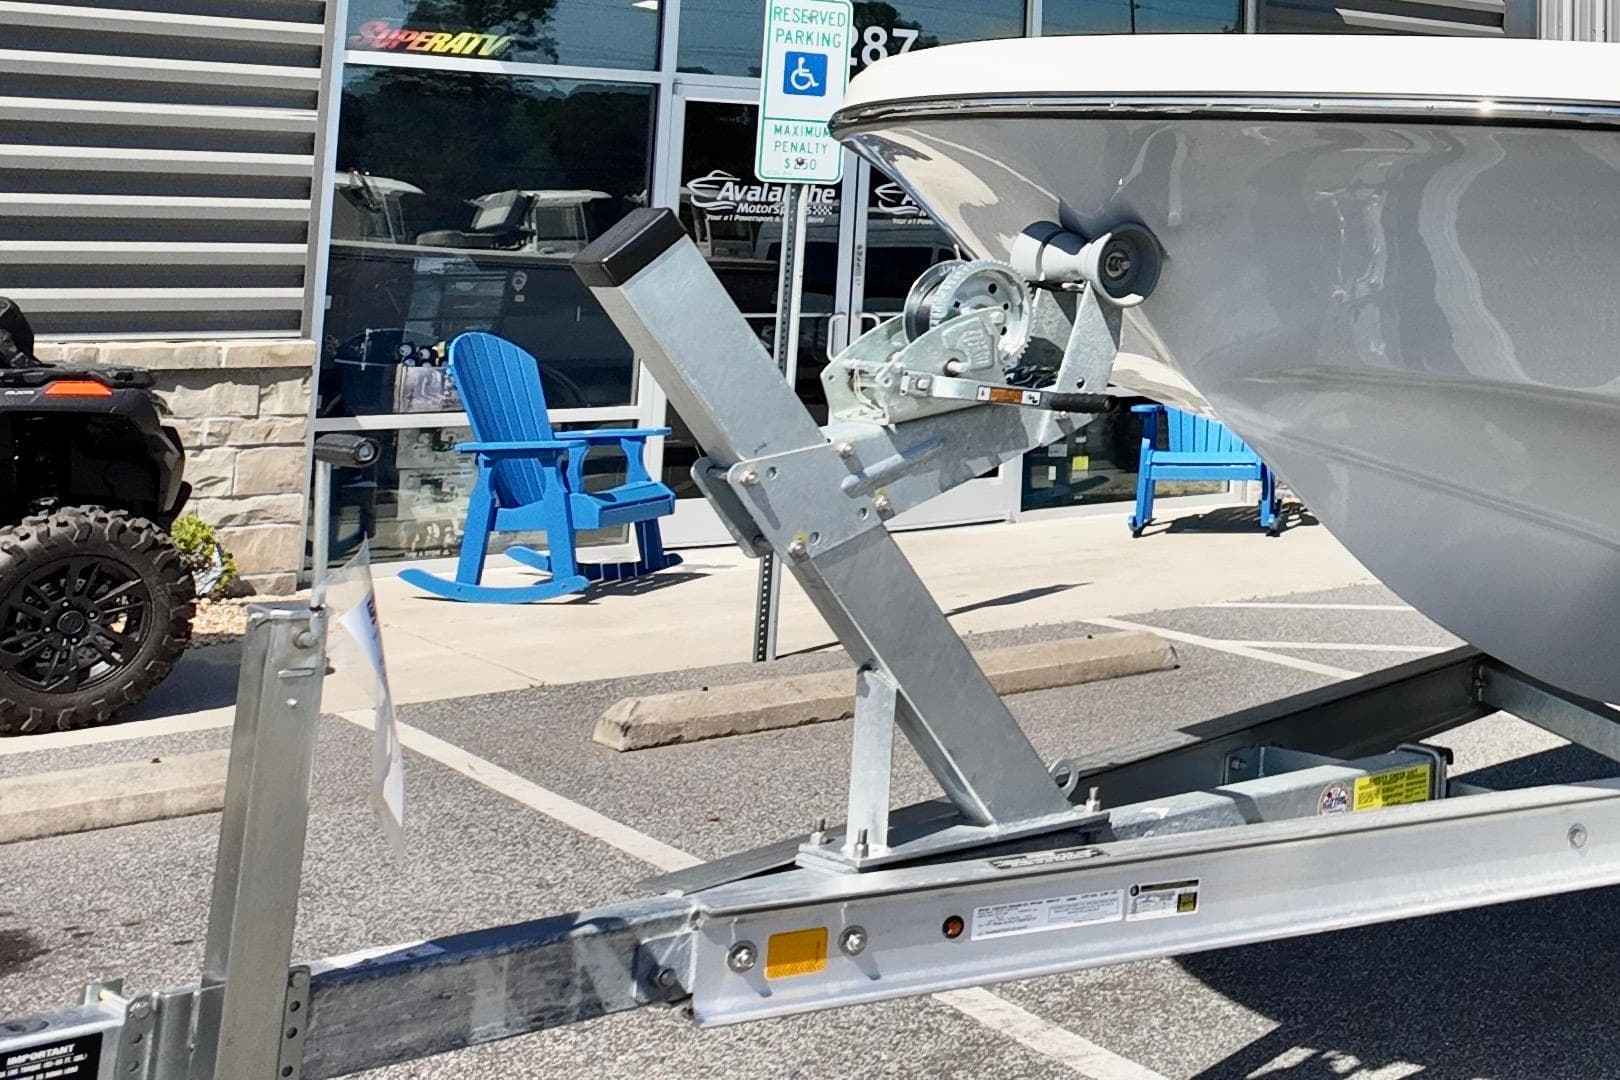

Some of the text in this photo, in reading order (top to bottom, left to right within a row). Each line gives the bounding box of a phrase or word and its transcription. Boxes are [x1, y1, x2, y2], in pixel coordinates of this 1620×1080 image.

[773, 6, 846, 27] RESERVED
[351, 20, 512, 56] SUPERATV
[776, 28, 842, 49] PARKING
[849, 25, 919, 67] 87
[774, 140, 829, 155] PENALTY
[716, 181, 836, 204] Avalahe
[7, 1043, 75, 1066] IMPORTANT
